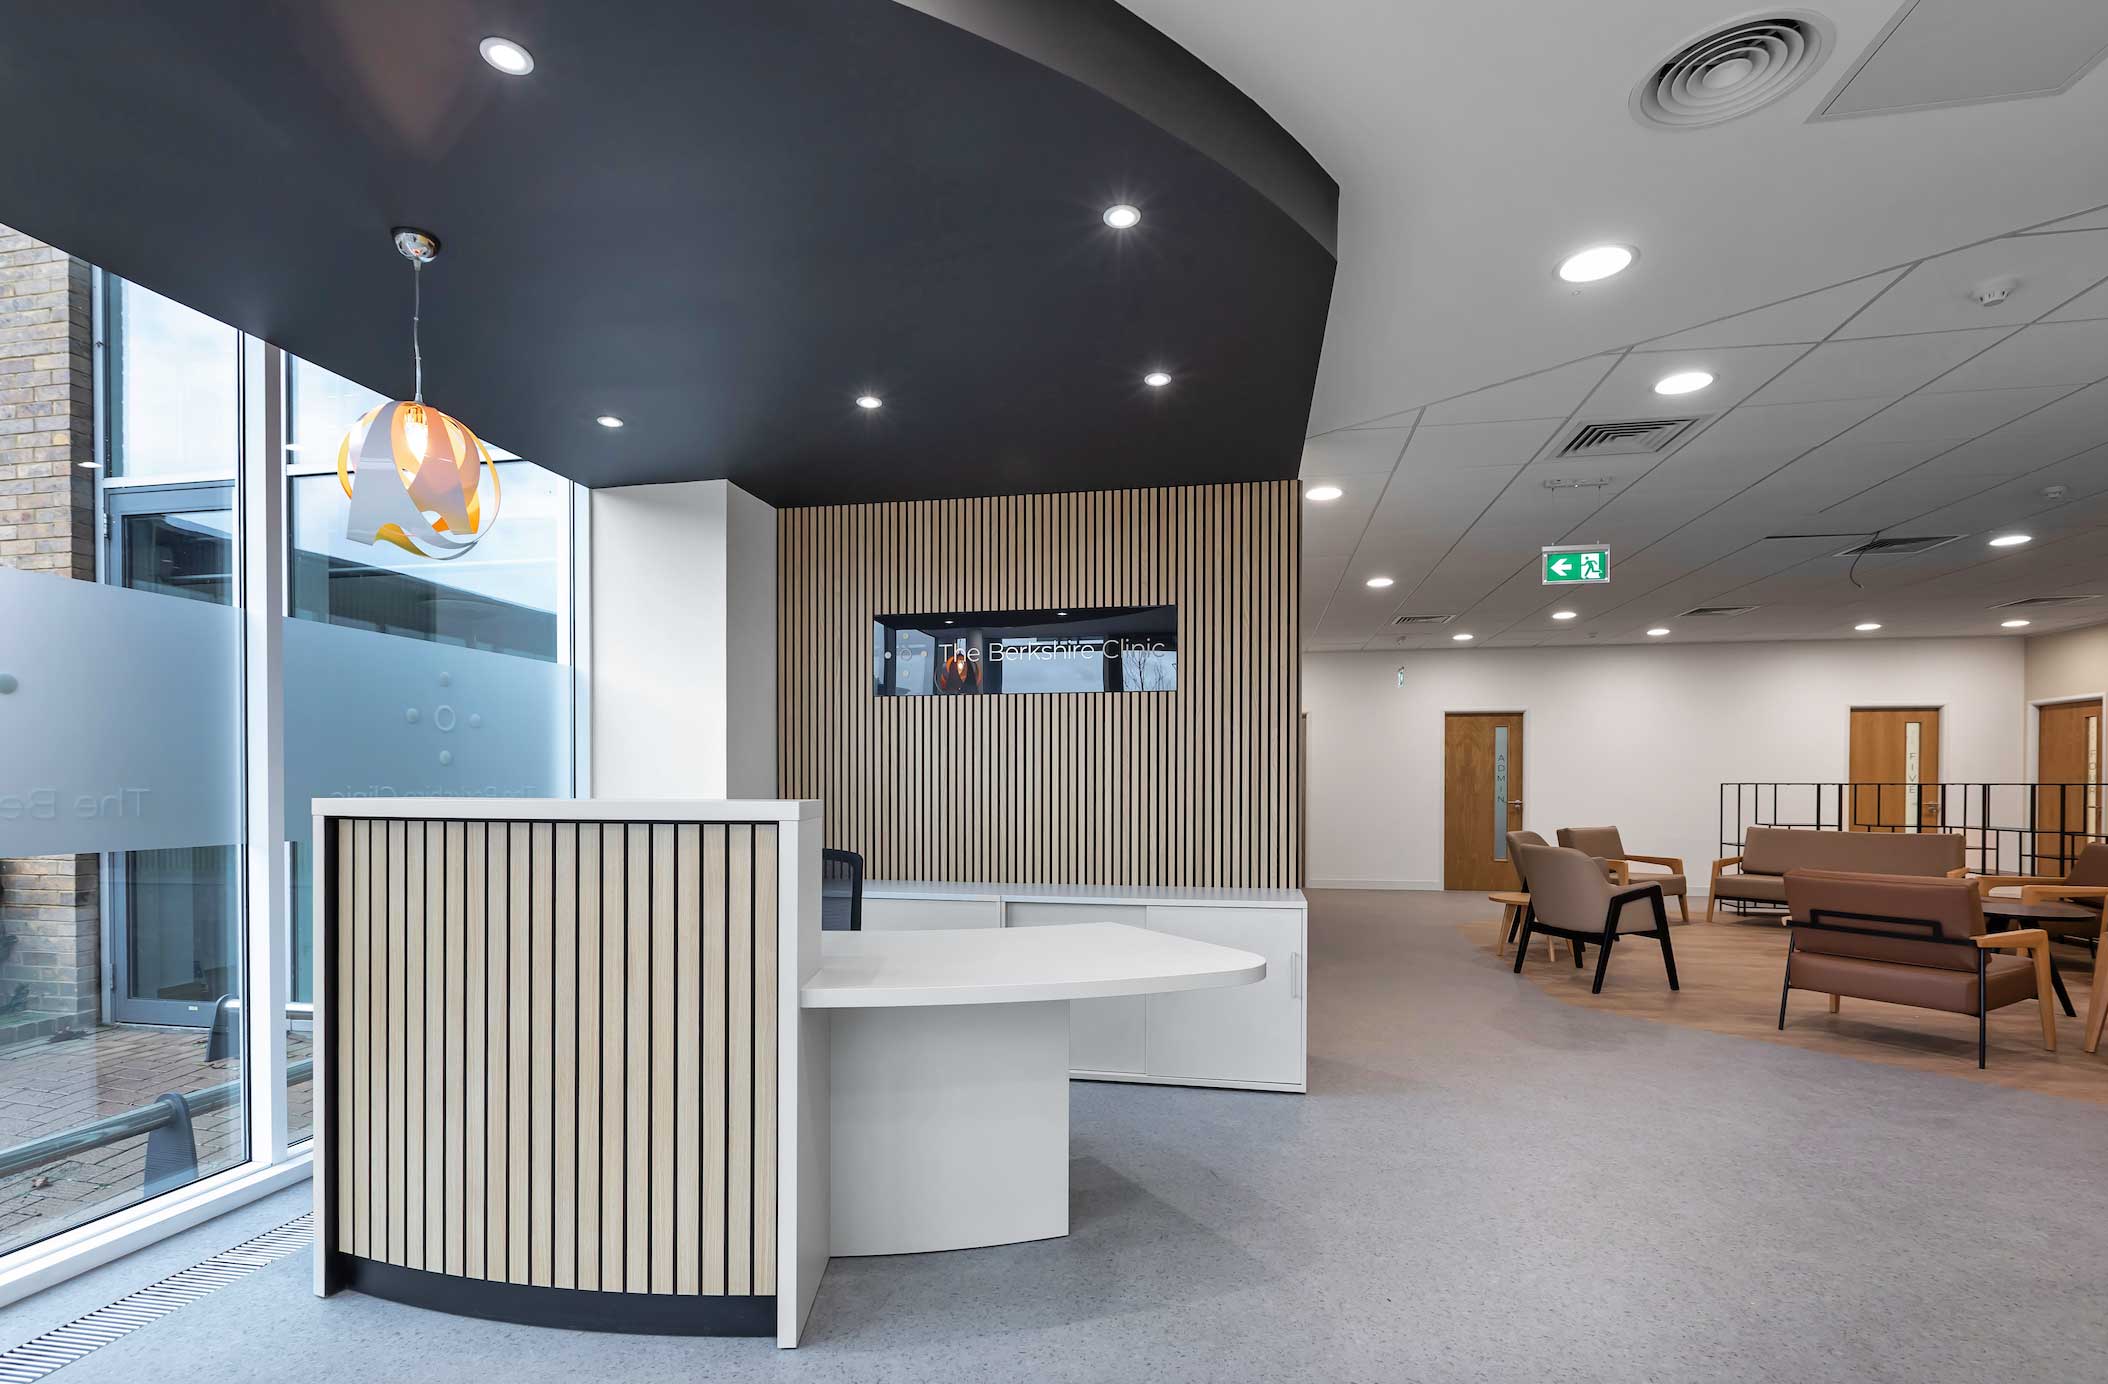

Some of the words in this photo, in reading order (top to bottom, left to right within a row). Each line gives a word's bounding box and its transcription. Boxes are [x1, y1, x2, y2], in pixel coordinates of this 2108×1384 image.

[938, 642, 980, 662] The
[989, 640, 1095, 662] Berkshire
[1102, 638, 1165, 660] Clinic
[1497, 754, 1505, 802] ADMIN
[1908, 752, 1917, 794] FIVE
